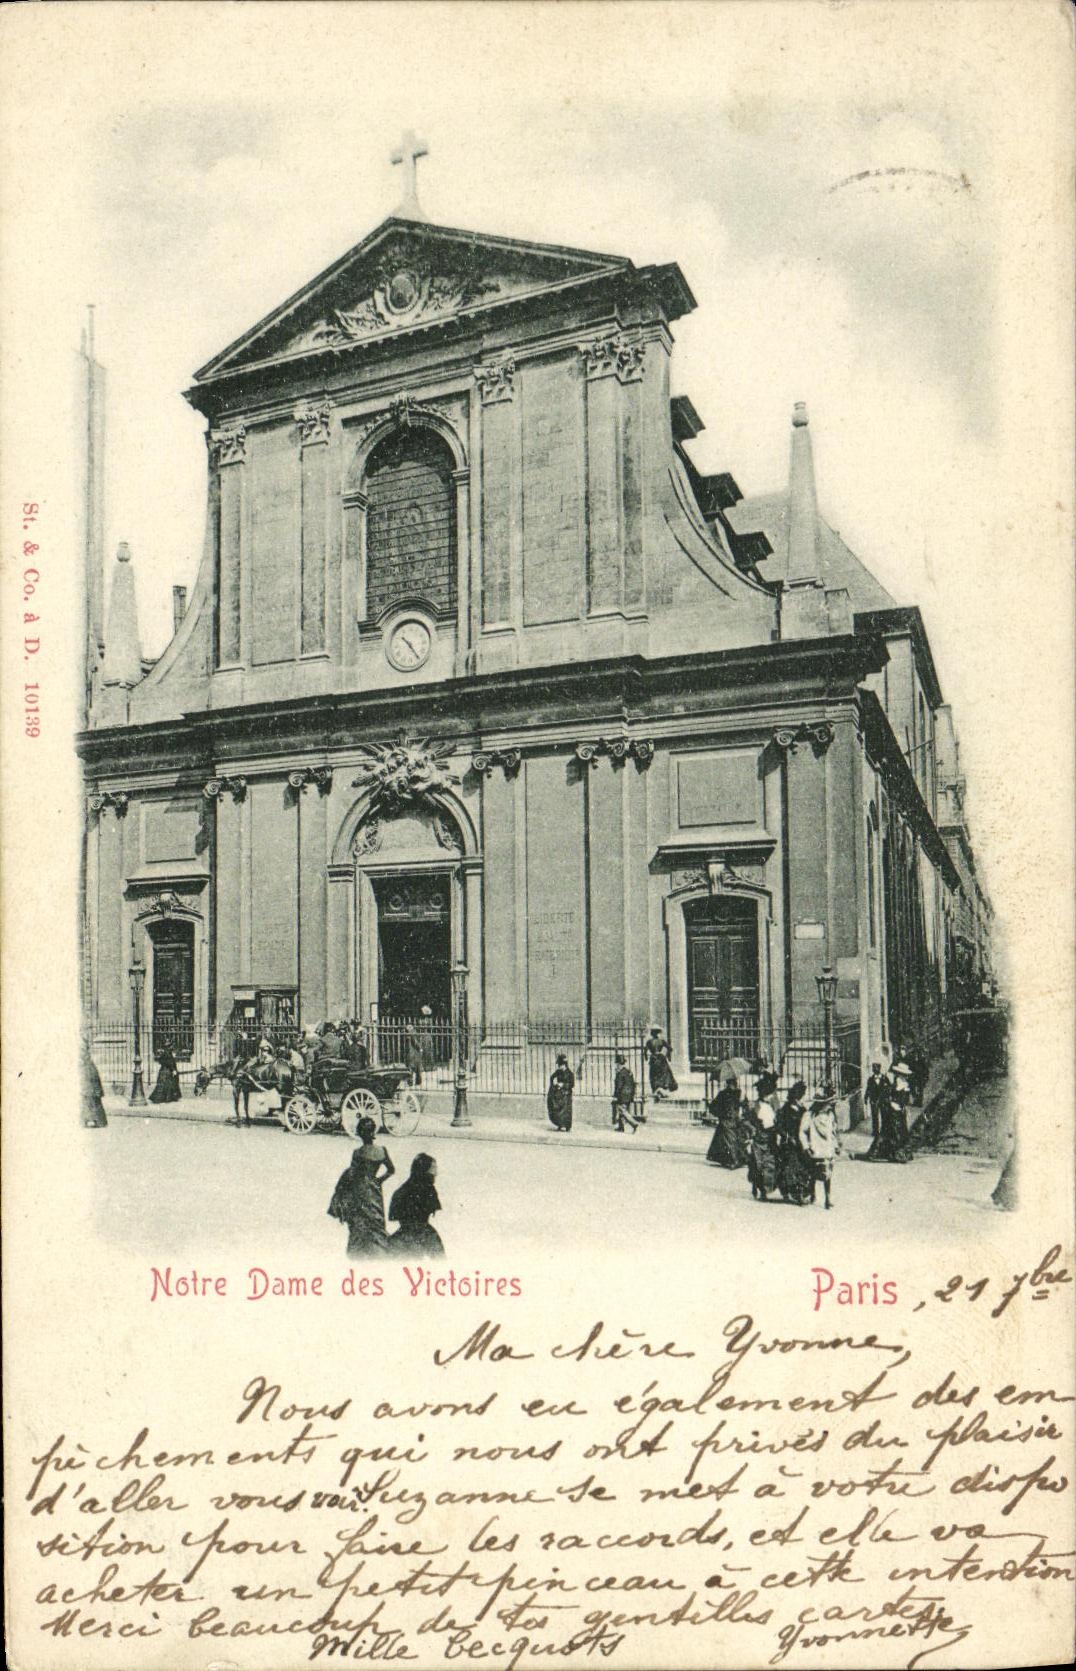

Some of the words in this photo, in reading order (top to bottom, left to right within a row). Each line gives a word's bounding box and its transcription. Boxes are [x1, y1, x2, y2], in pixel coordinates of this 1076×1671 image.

[434, 1320, 534, 1366] Ma
[551, 1322, 695, 1361] chère
[712, 1315, 911, 1384] Yvonne,
[236, 1376, 351, 1424] Nous
[373, 1392, 498, 1419] avons
[521, 1399, 587, 1416] eu
[613, 1371, 897, 1446] également
[912, 1370, 980, 1408] des
[340, 1433, 429, 1487] qui
[453, 1440, 562, 1462] nous
[583, 1420, 668, 1461] ont
[684, 1420, 829, 1484] privés
[842, 1419, 909, 1450] du
[927, 1410, 1063, 1471] plaisir
[31, 1473, 188, 1516] d'aller
[210, 1490, 307, 1513] vous
[355, 1468, 555, 1523] Suzanne
[641, 1463, 748, 1501] met
[753, 1465, 803, 1499] à
[811, 1458, 936, 1498] votre
[950, 1455, 1068, 1516] dispo
[36, 1517, 165, 1560] sition
[181, 1518, 306, 1583] pour
[322, 1514, 448, 1562] faire
[468, 1516, 519, 1552] les
[749, 1506, 809, 1546] et
[819, 1507, 917, 1546] elle
[930, 1523, 1048, 1541] va
[36, 1564, 203, 1605] acheter
[232, 1584, 312, 1601] un
[317, 1555, 480, 1622] petit
[472, 1562, 686, 1621] pinceau
[705, 1564, 752, 1588] à
[760, 1549, 865, 1587] cette
[888, 1540, 1076, 1582] intention
[40, 1609, 162, 1637] Merci
[188, 1601, 402, 1642] beaucoup
[417, 1605, 477, 1634] de
[584, 1590, 774, 1634] gentilles
[308, 1631, 420, 1661] Mille
